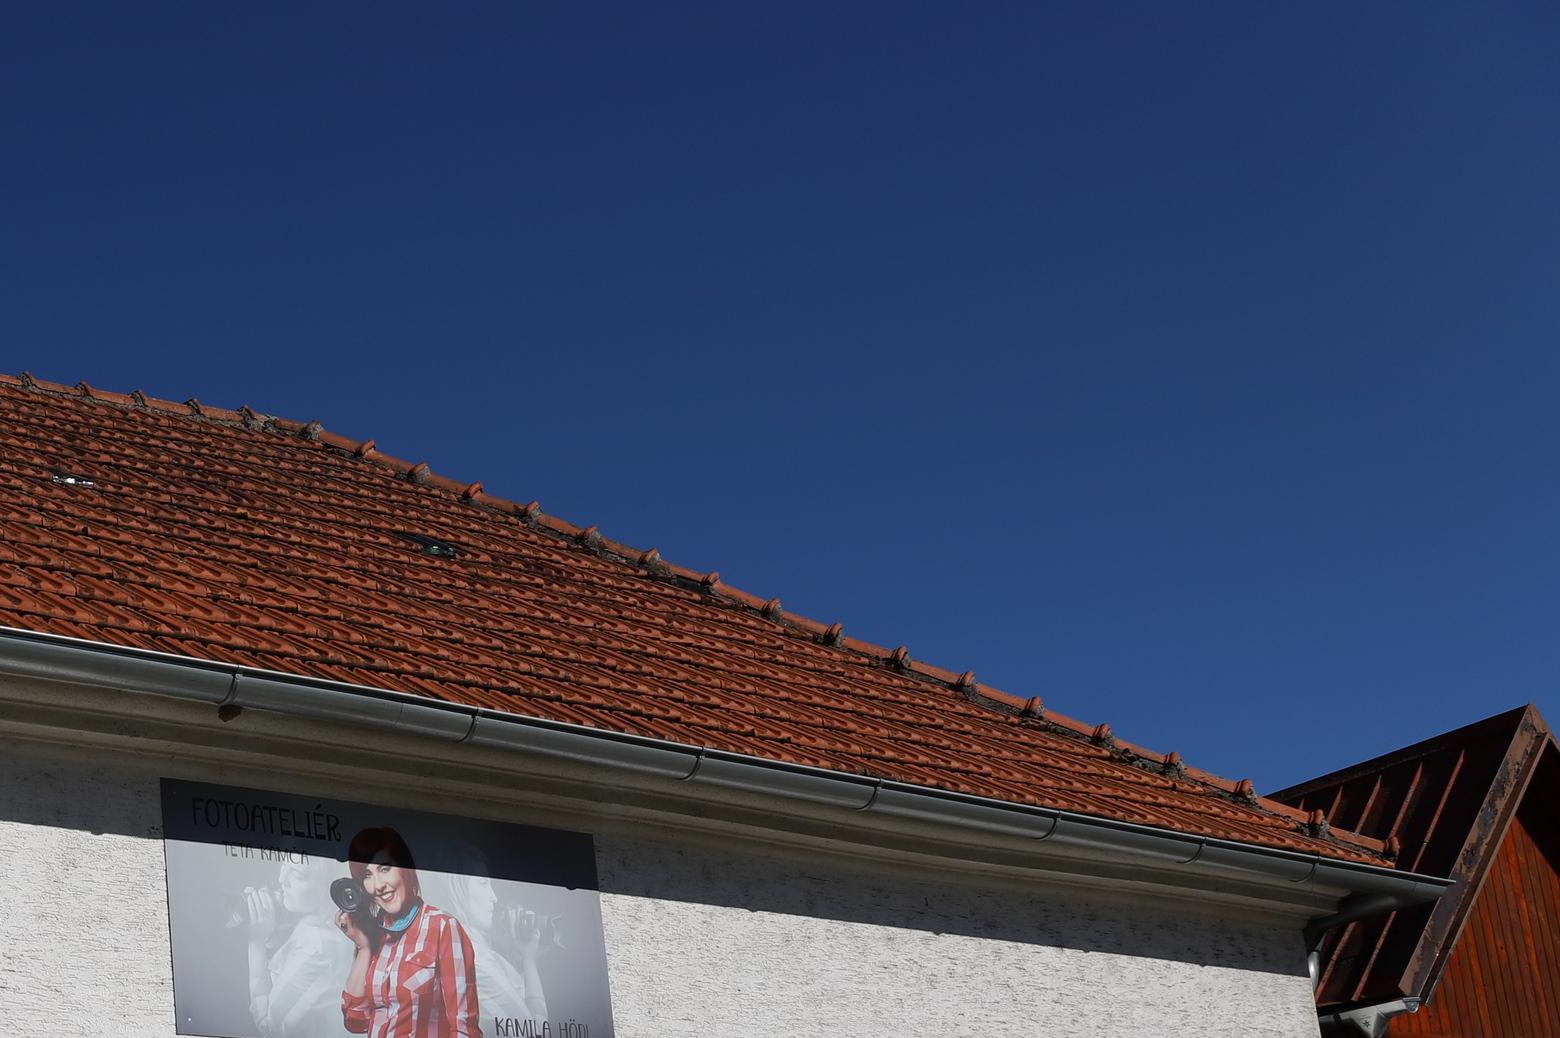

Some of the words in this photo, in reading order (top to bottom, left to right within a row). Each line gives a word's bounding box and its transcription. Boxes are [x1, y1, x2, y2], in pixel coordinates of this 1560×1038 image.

[191, 797, 342, 842] FOTOATELIÉR
[222, 840, 254, 859] TETA
[260, 844, 310, 865] KAMČA
